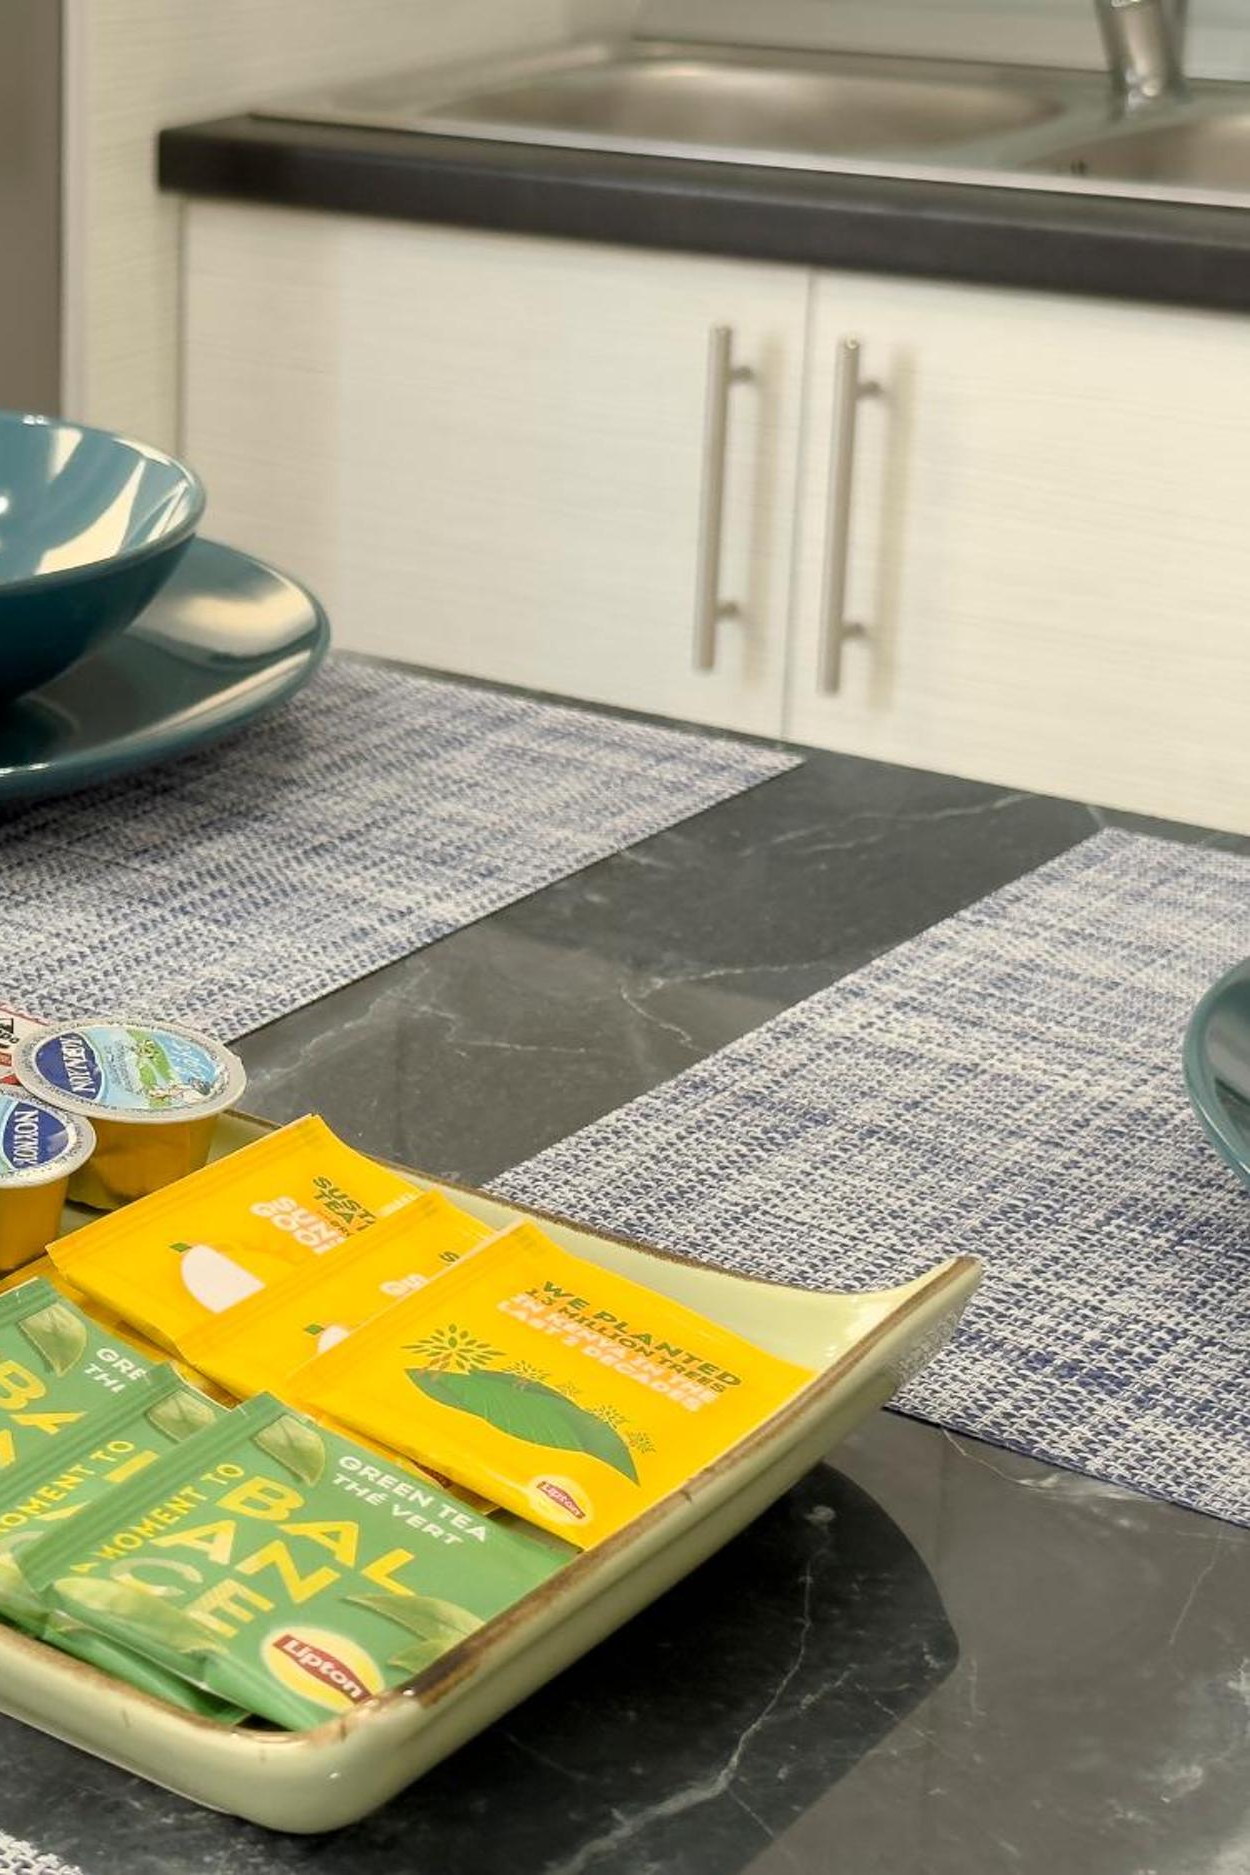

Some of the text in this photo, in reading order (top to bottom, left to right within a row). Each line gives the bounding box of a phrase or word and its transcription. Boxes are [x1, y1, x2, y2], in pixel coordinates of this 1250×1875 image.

[95, 1346, 149, 1382] GRE
[543, 1280, 742, 1387] WE PLANTED
[556, 1306, 655, 1358] MILLION
[657, 1357, 726, 1394] TREES
[89, 1439, 136, 1464] TO
[94, 1484, 210, 1561] MOMENT
[200, 1462, 246, 1487] TO
[330, 1472, 465, 1546] THÉ VERT
[336, 1454, 491, 1544] GREEN TEA
[281, 1636, 365, 1702] Lipton
